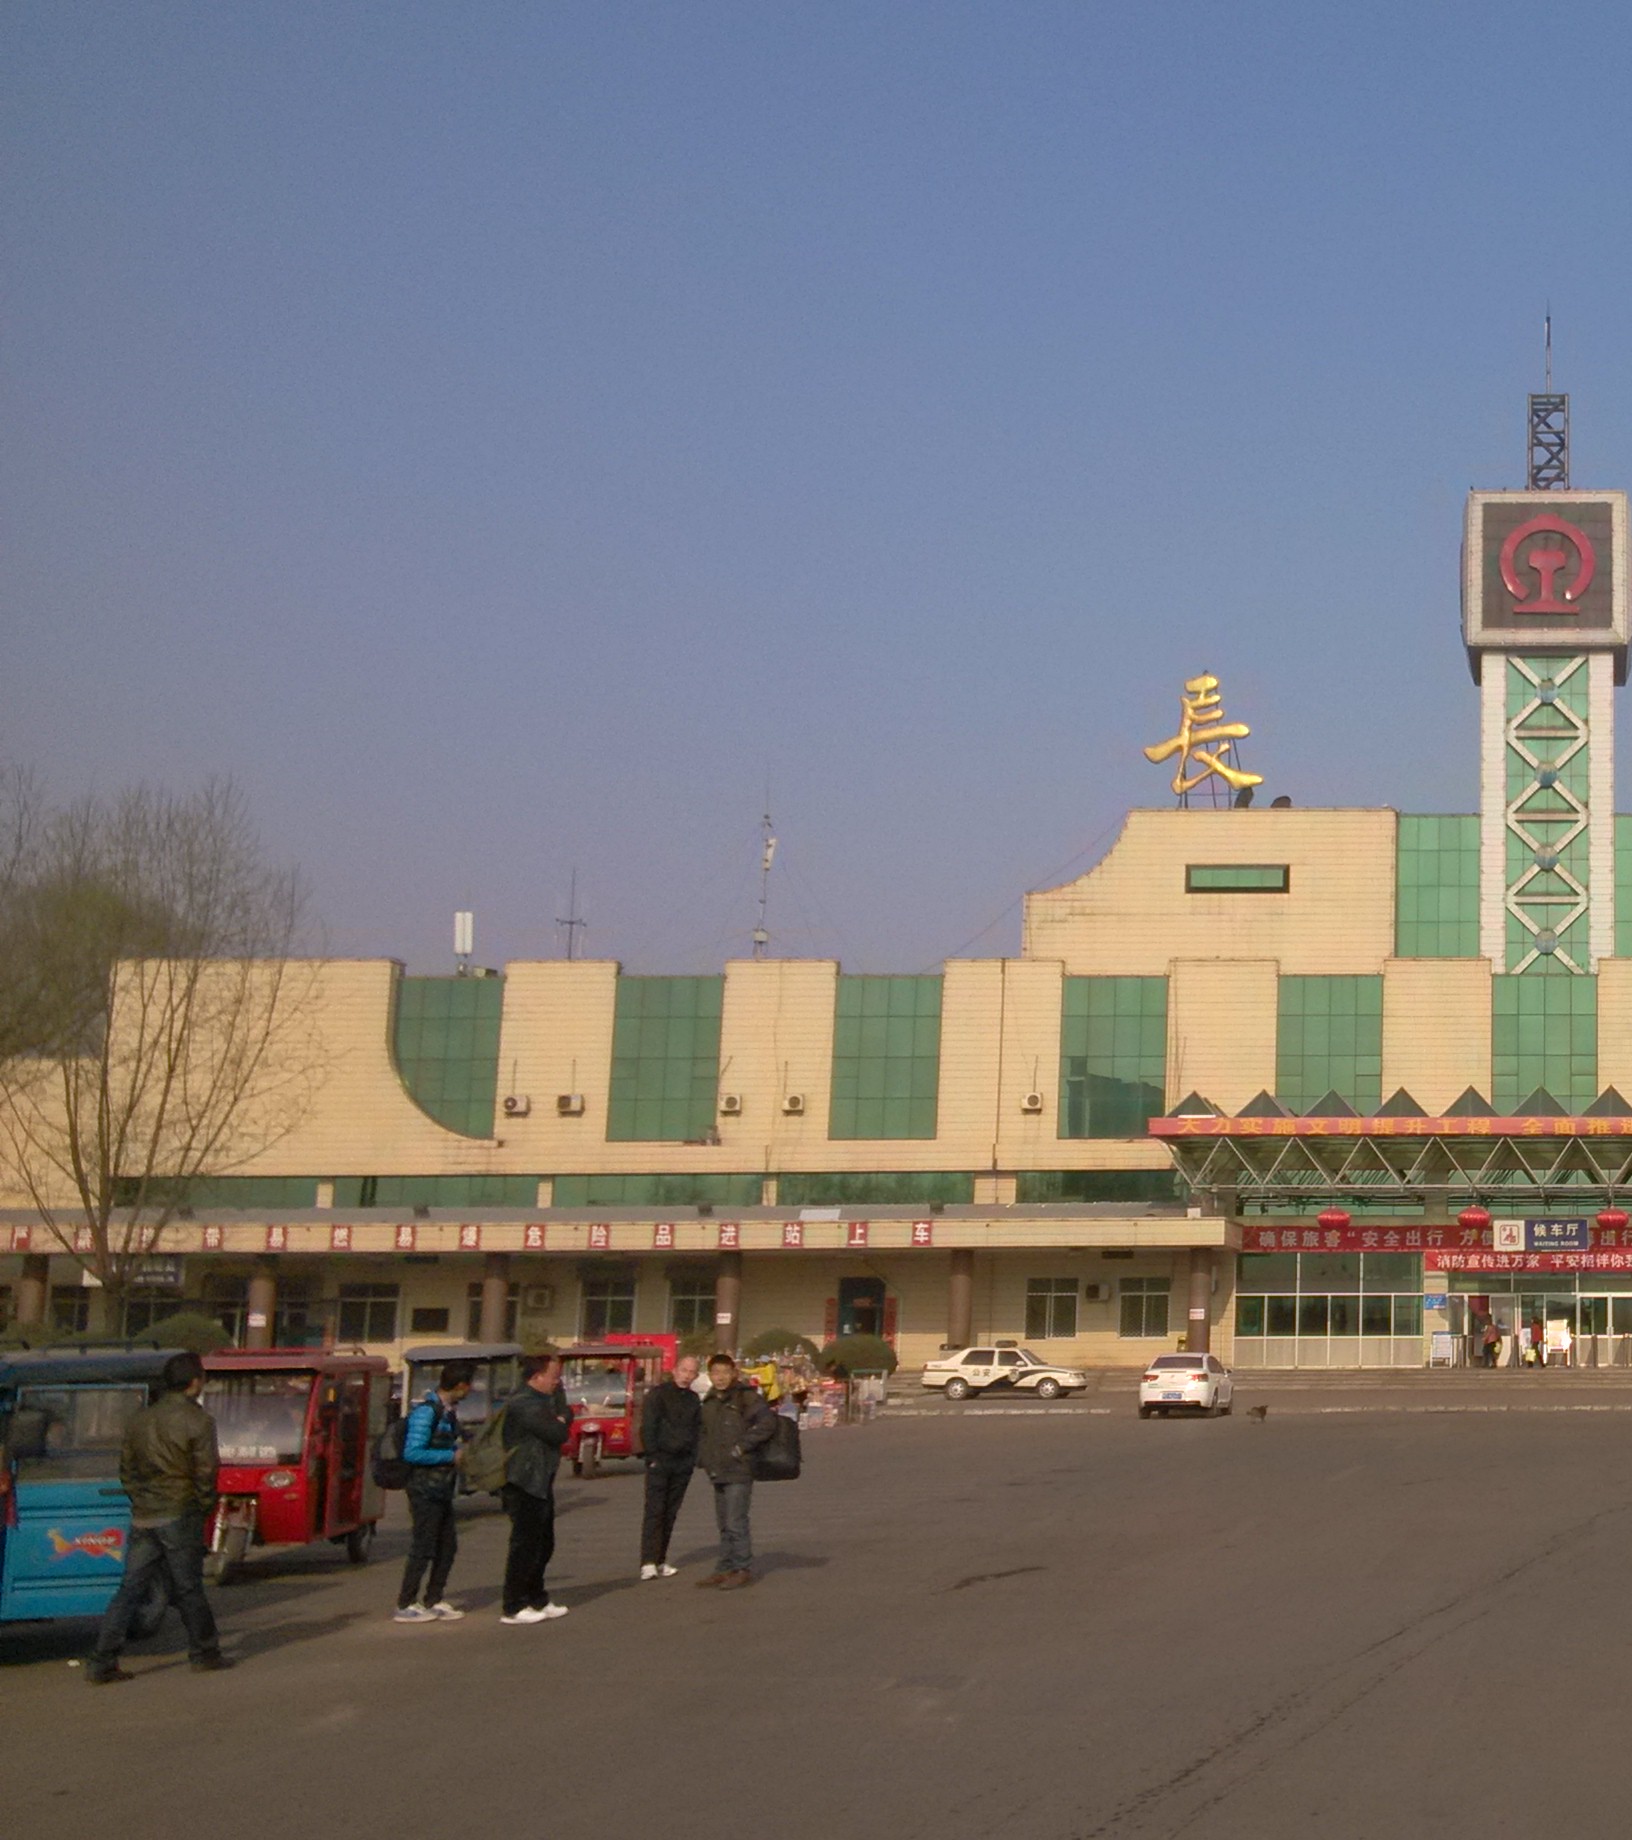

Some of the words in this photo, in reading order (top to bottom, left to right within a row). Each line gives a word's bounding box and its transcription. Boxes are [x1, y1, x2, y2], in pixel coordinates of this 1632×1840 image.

[1143, 671, 1264, 793] 長
[1533, 1223, 1579, 1237] 候车厅
[1436, 1254, 1540, 1269] 消防宣传进万家
[972, 1368, 990, 1377] 公安
